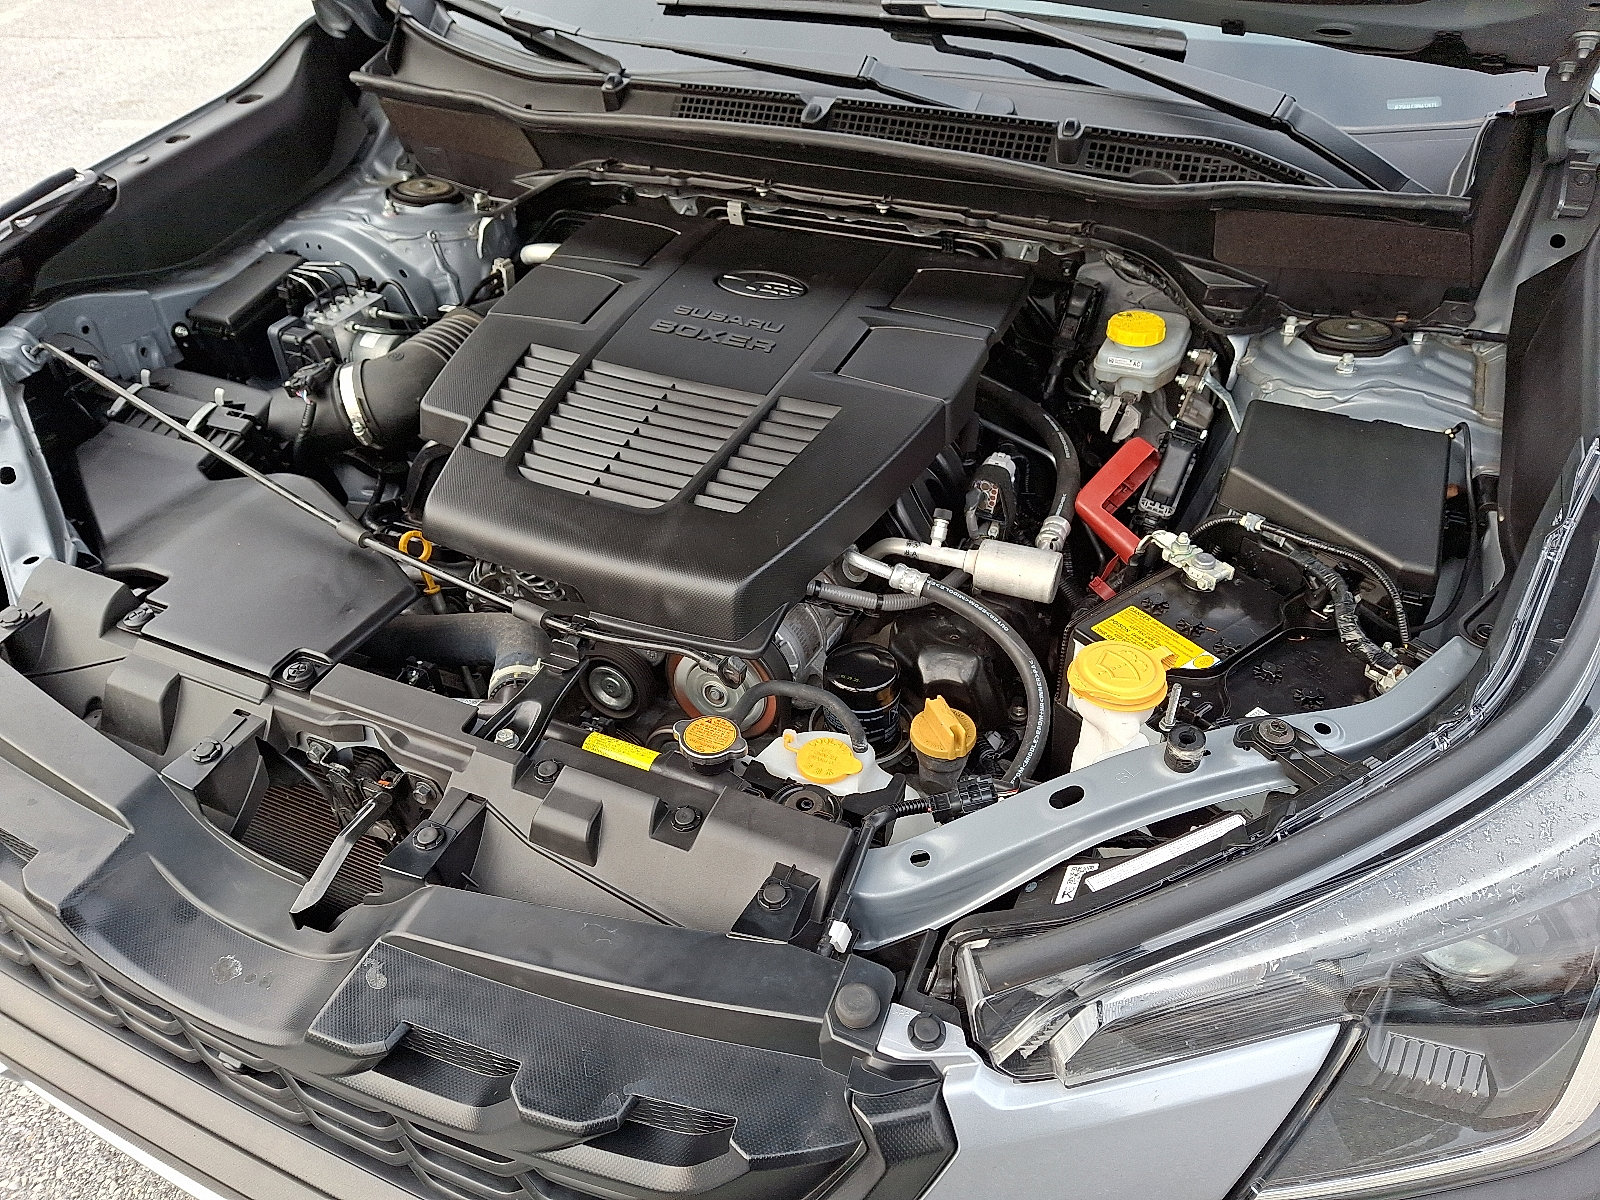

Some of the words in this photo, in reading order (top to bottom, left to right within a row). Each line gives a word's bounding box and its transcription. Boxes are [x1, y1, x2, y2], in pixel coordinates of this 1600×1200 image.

[673, 304, 785, 334] SUBARU
[650, 318, 777, 354] BOXER
[1109, 618, 1131, 633] POISON
[1128, 607, 1152, 622] DANGER
